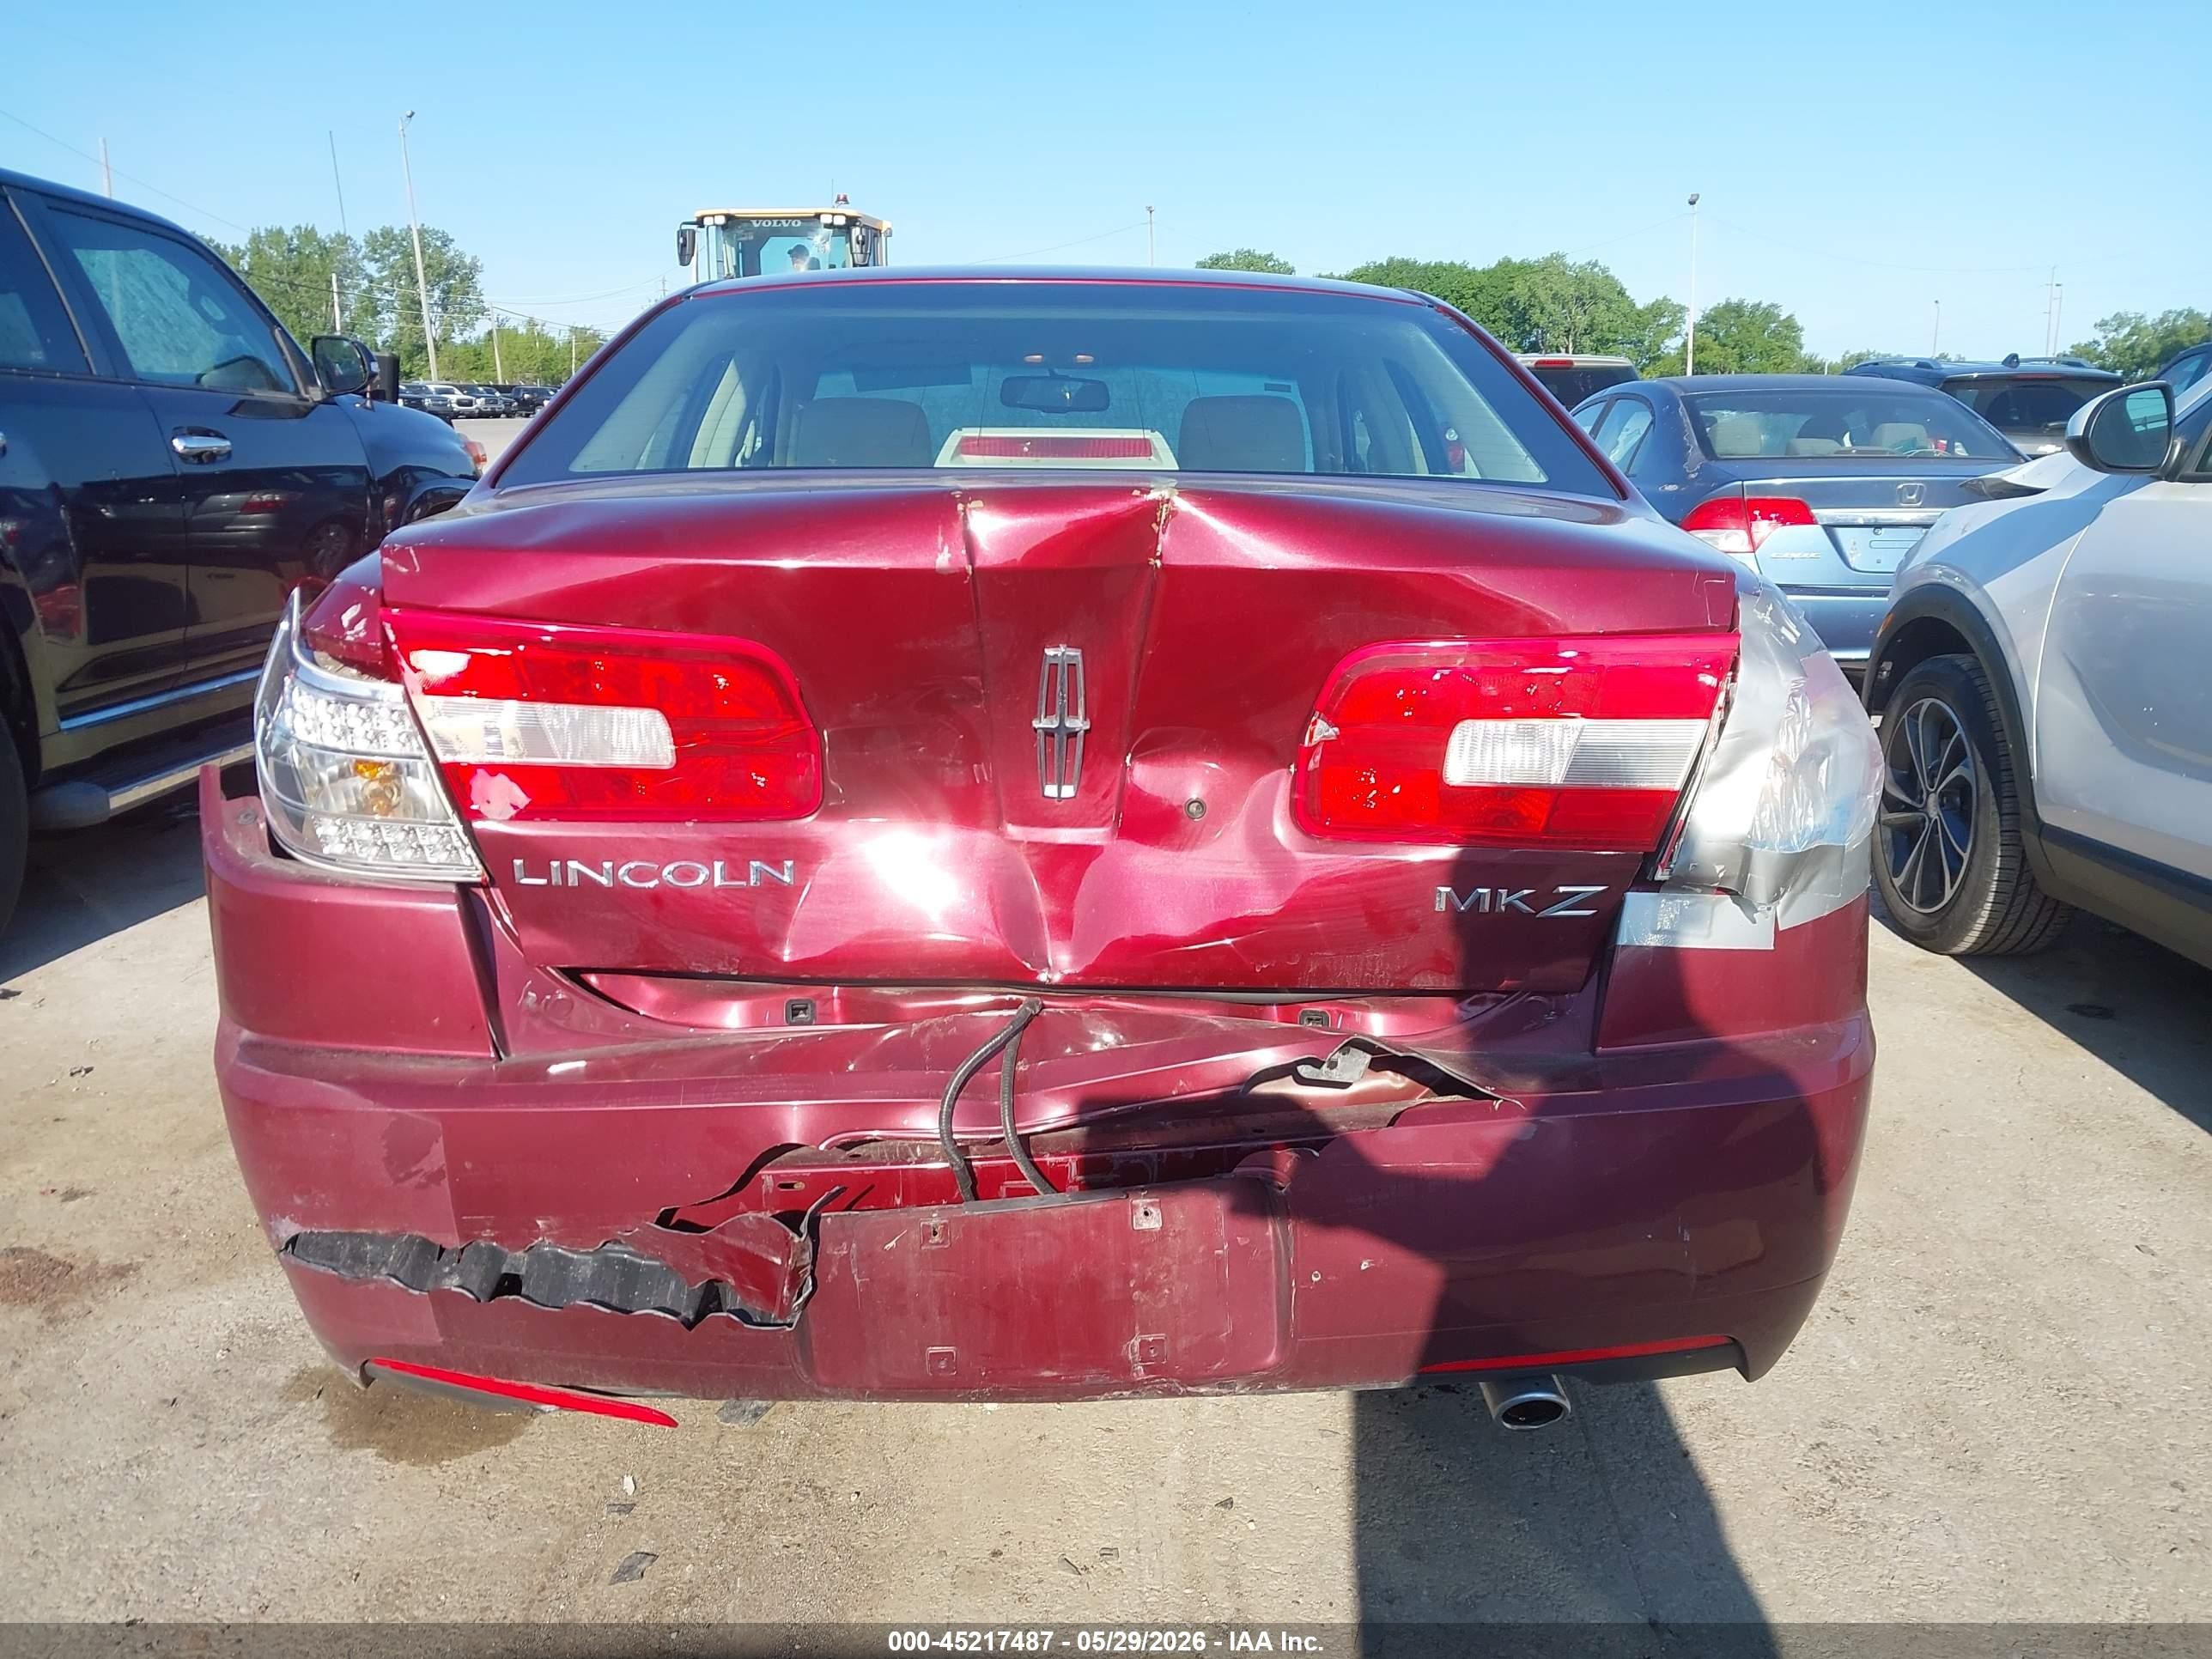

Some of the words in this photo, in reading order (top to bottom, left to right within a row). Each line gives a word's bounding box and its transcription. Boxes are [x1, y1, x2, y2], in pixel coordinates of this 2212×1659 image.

[750, 219, 802, 228] VOLVO
[513, 859, 794, 888] LINCOLN
[1435, 885, 1609, 918] MKZ
